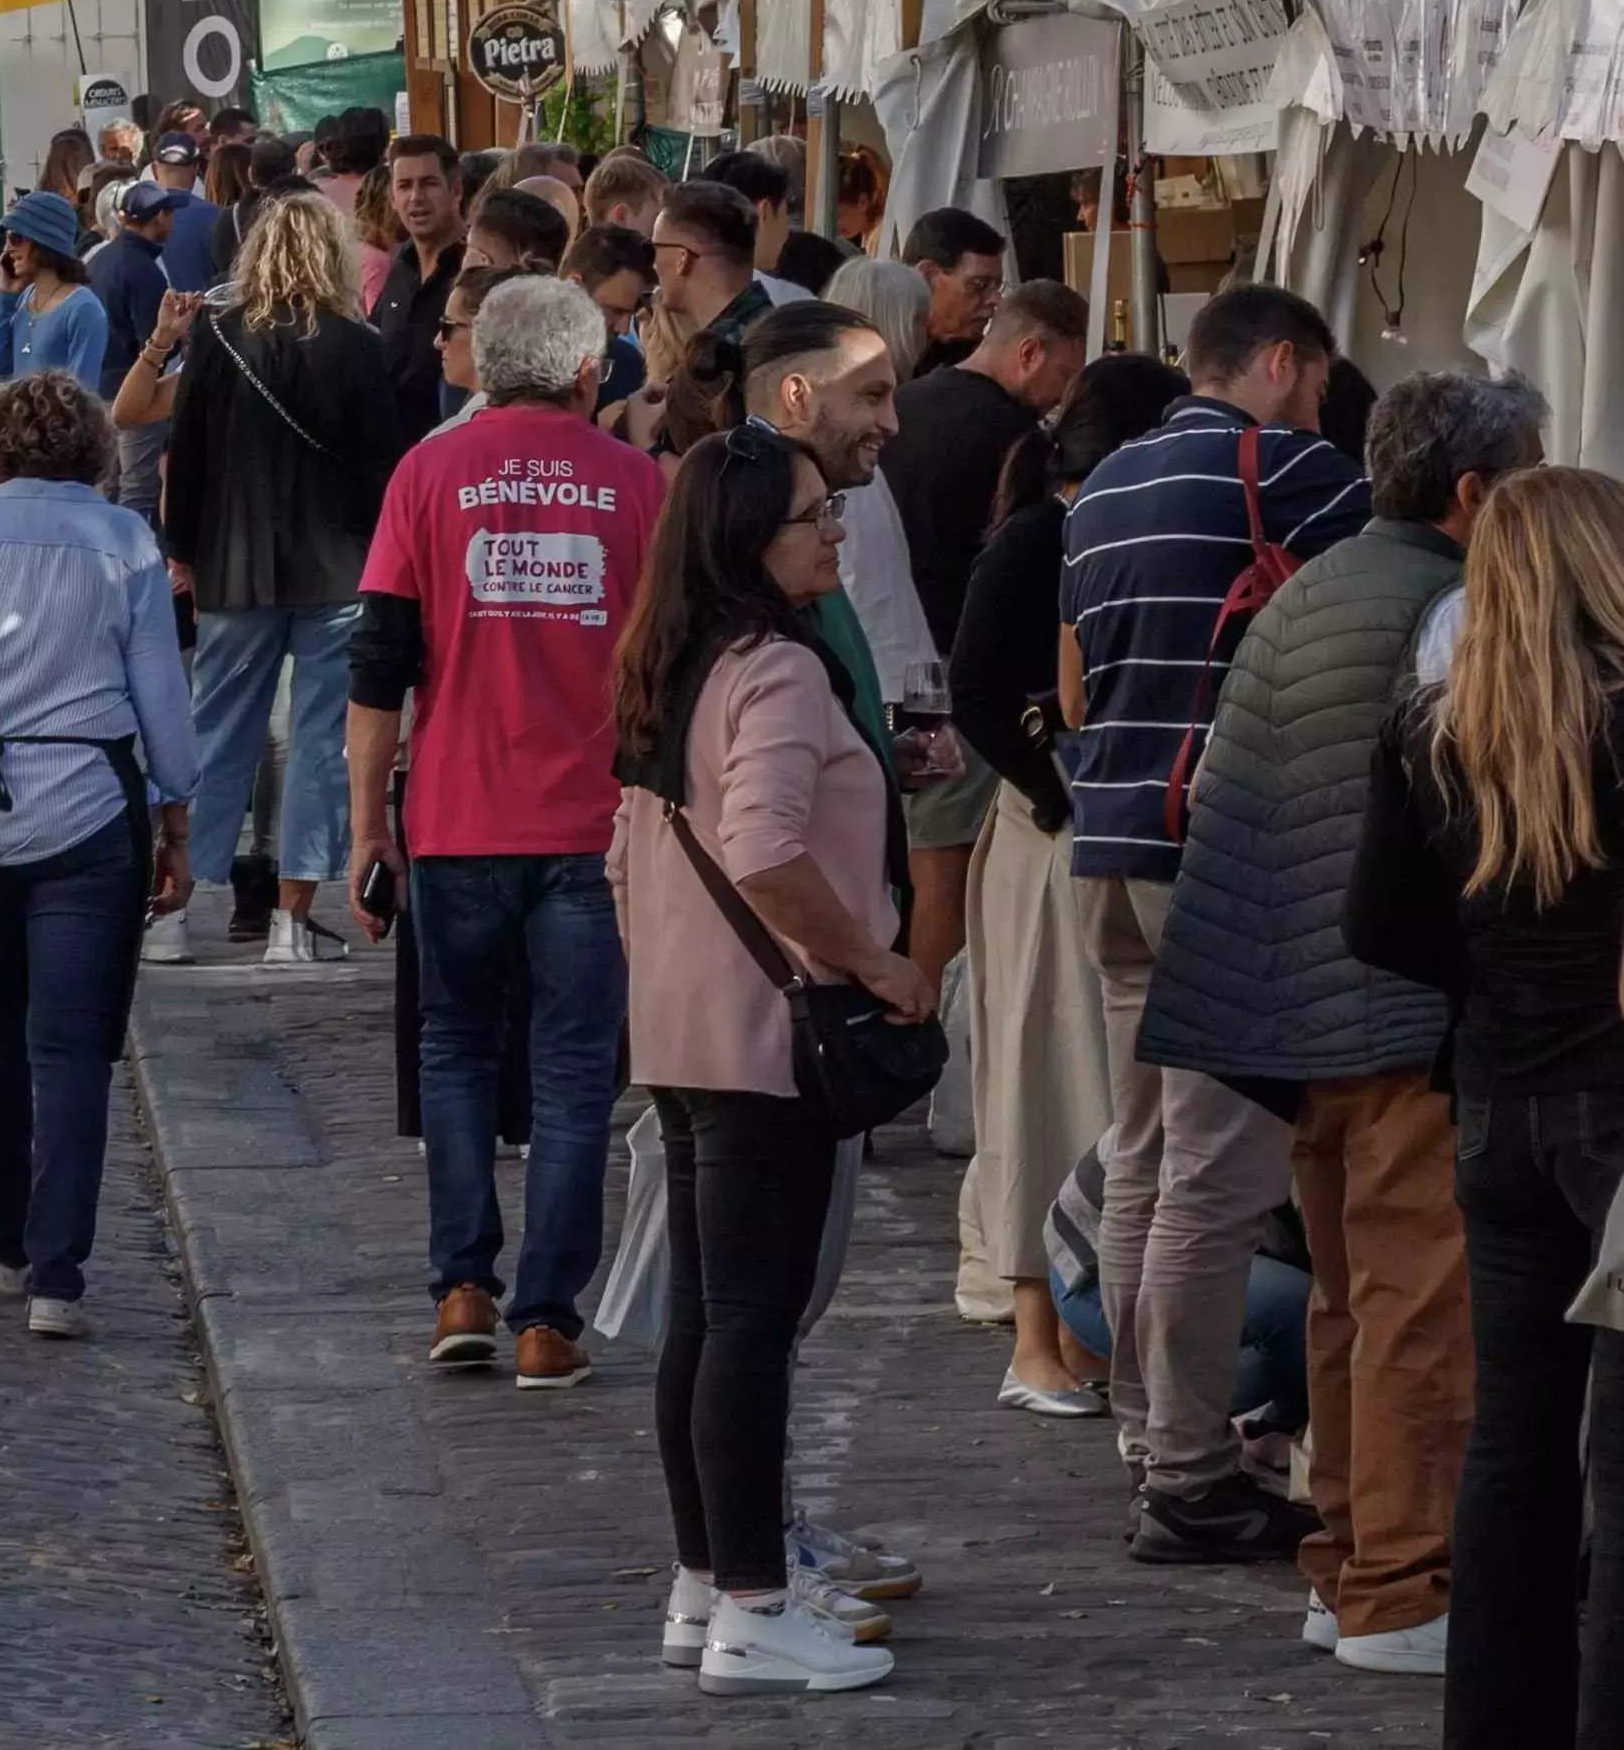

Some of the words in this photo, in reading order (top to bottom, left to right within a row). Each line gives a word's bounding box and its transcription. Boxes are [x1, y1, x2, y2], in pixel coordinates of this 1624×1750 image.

[483, 36, 556, 69] Pietra
[498, 458, 522, 477] JE
[527, 459, 574, 478] SUIS
[457, 476, 617, 513] BÉNÉVOLE
[483, 539, 540, 557] TOUT
[484, 559, 506, 577] LE
[511, 559, 589, 579] MONDE
[483, 581, 526, 593] CONTRE
[529, 582, 542, 593] LE
[546, 583, 594, 595] CANCER
